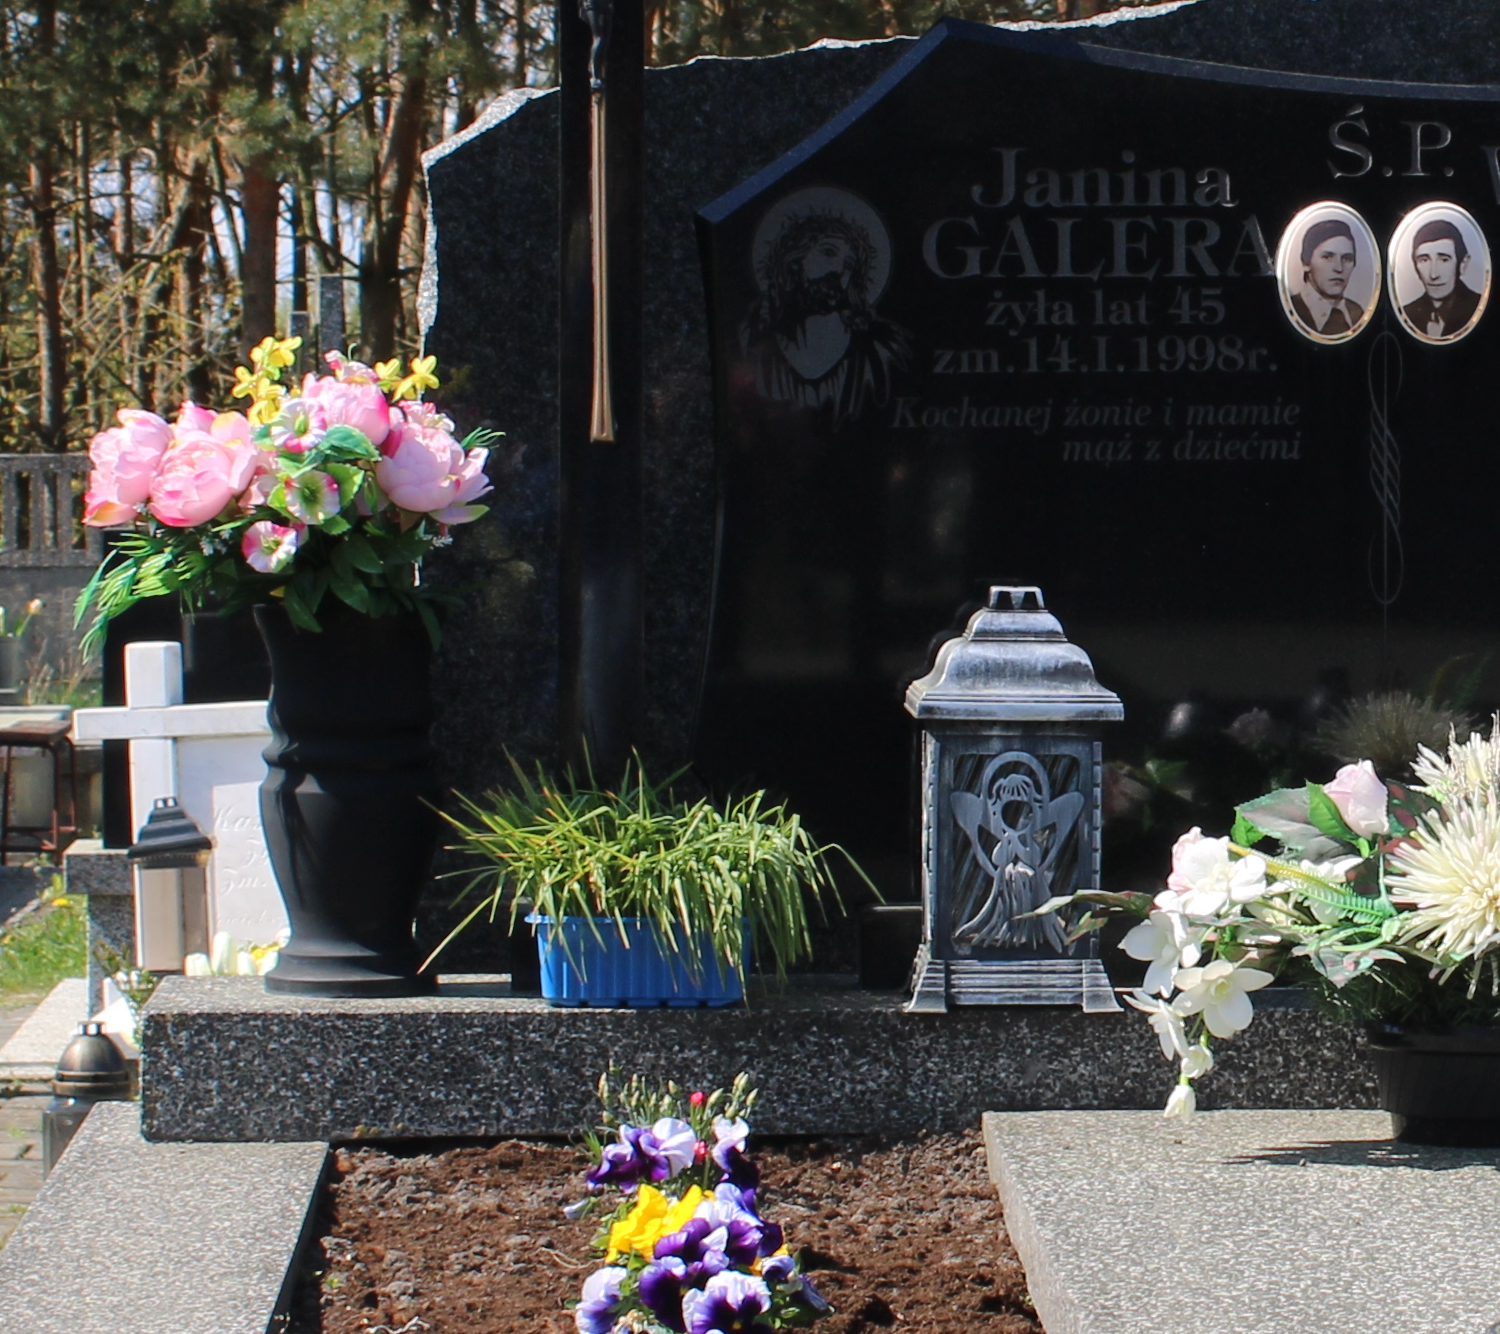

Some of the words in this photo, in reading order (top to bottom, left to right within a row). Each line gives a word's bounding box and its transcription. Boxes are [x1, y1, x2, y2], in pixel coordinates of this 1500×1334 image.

[970, 147, 1240, 208] Janina
[921, 214, 1276, 282] GALERA
[985, 288, 1076, 337] żyła
[1091, 288, 1152, 326] lat
[1168, 285, 1227, 326] 45
[892, 396, 1053, 436] Kochanej
[1063, 397, 1152, 427] żonie
[1163, 397, 1175, 427] i
[1186, 396, 1301, 427] mamie
[1062, 432, 1132, 468] mąż
[1144, 439, 1161, 462] z
[1172, 430, 1302, 462] dziećmi
